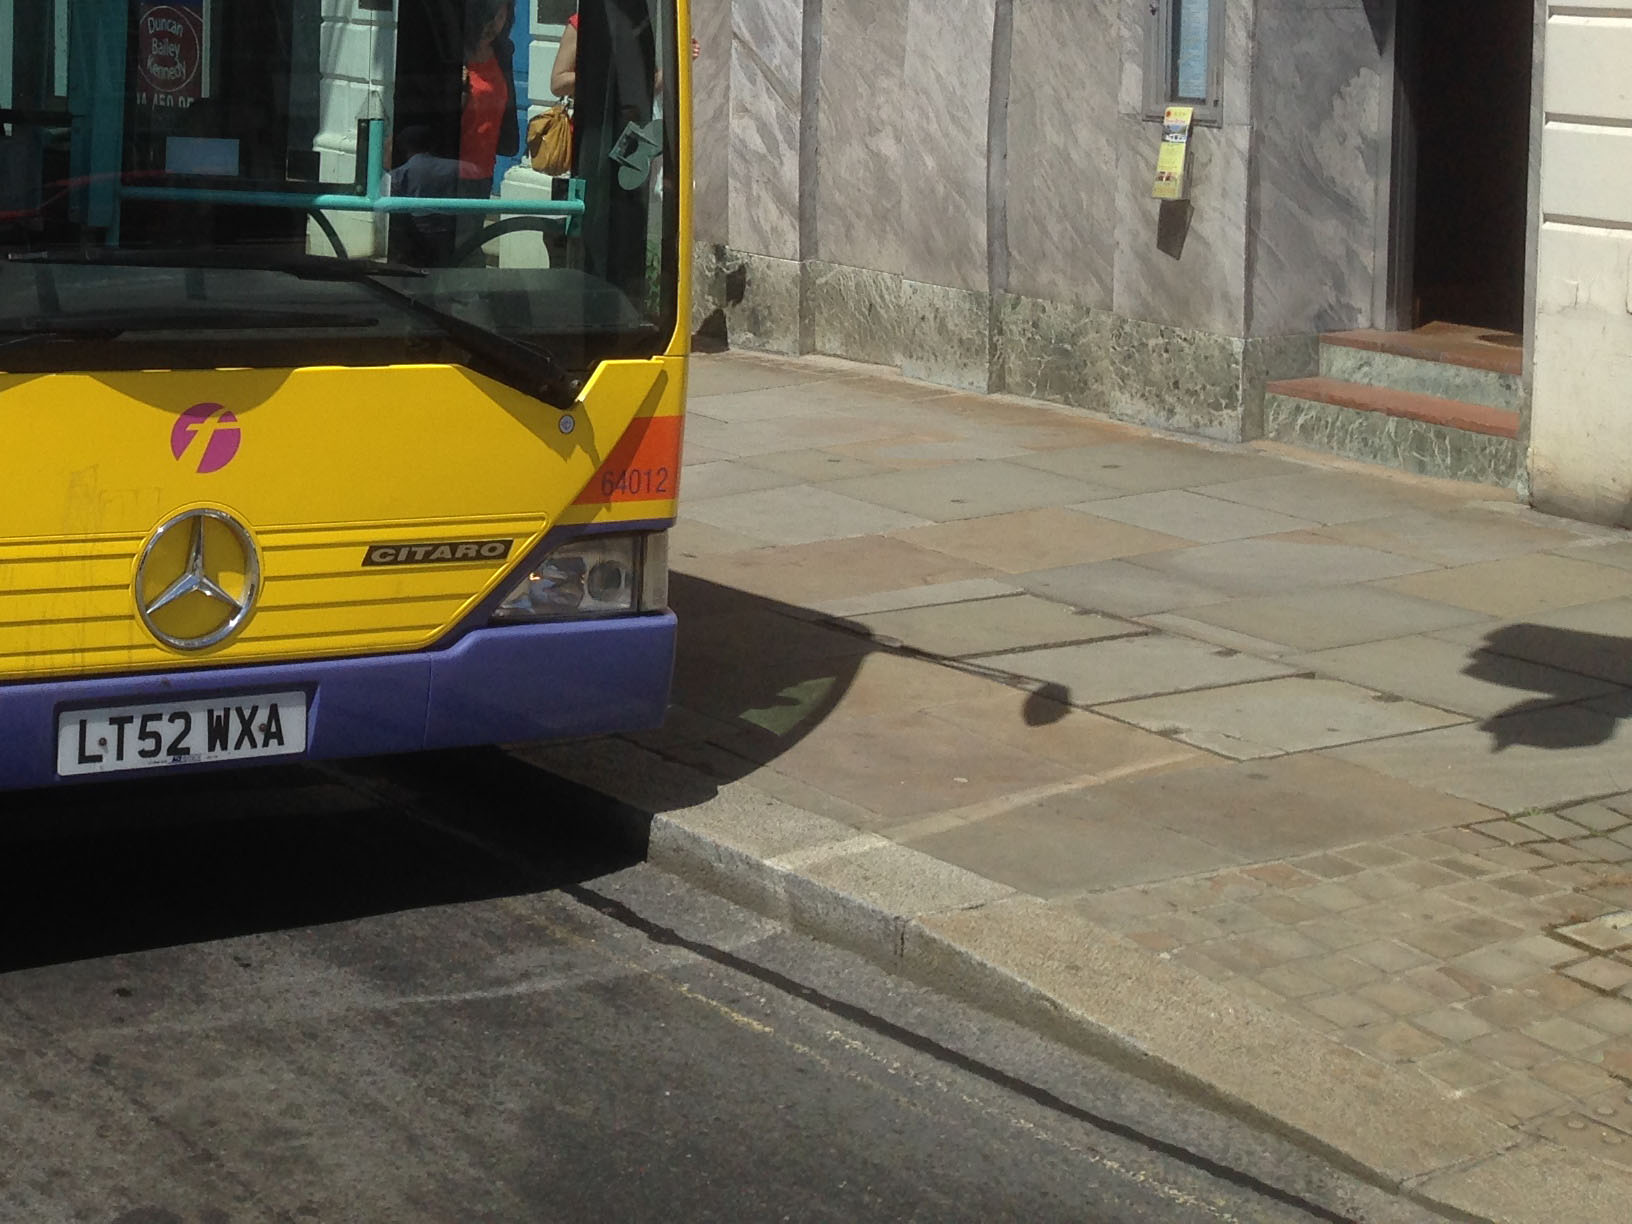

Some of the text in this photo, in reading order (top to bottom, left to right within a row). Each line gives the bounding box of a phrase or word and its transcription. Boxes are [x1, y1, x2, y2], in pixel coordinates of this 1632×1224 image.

[147, 17, 184, 37] Duncan
[151, 37, 181, 59] Bailey
[146, 54, 186, 80] Kennedy
[601, 466, 668, 497] 64012
[370, 542, 505, 563] CITARO
[78, 703, 285, 765] LT52 WXA
